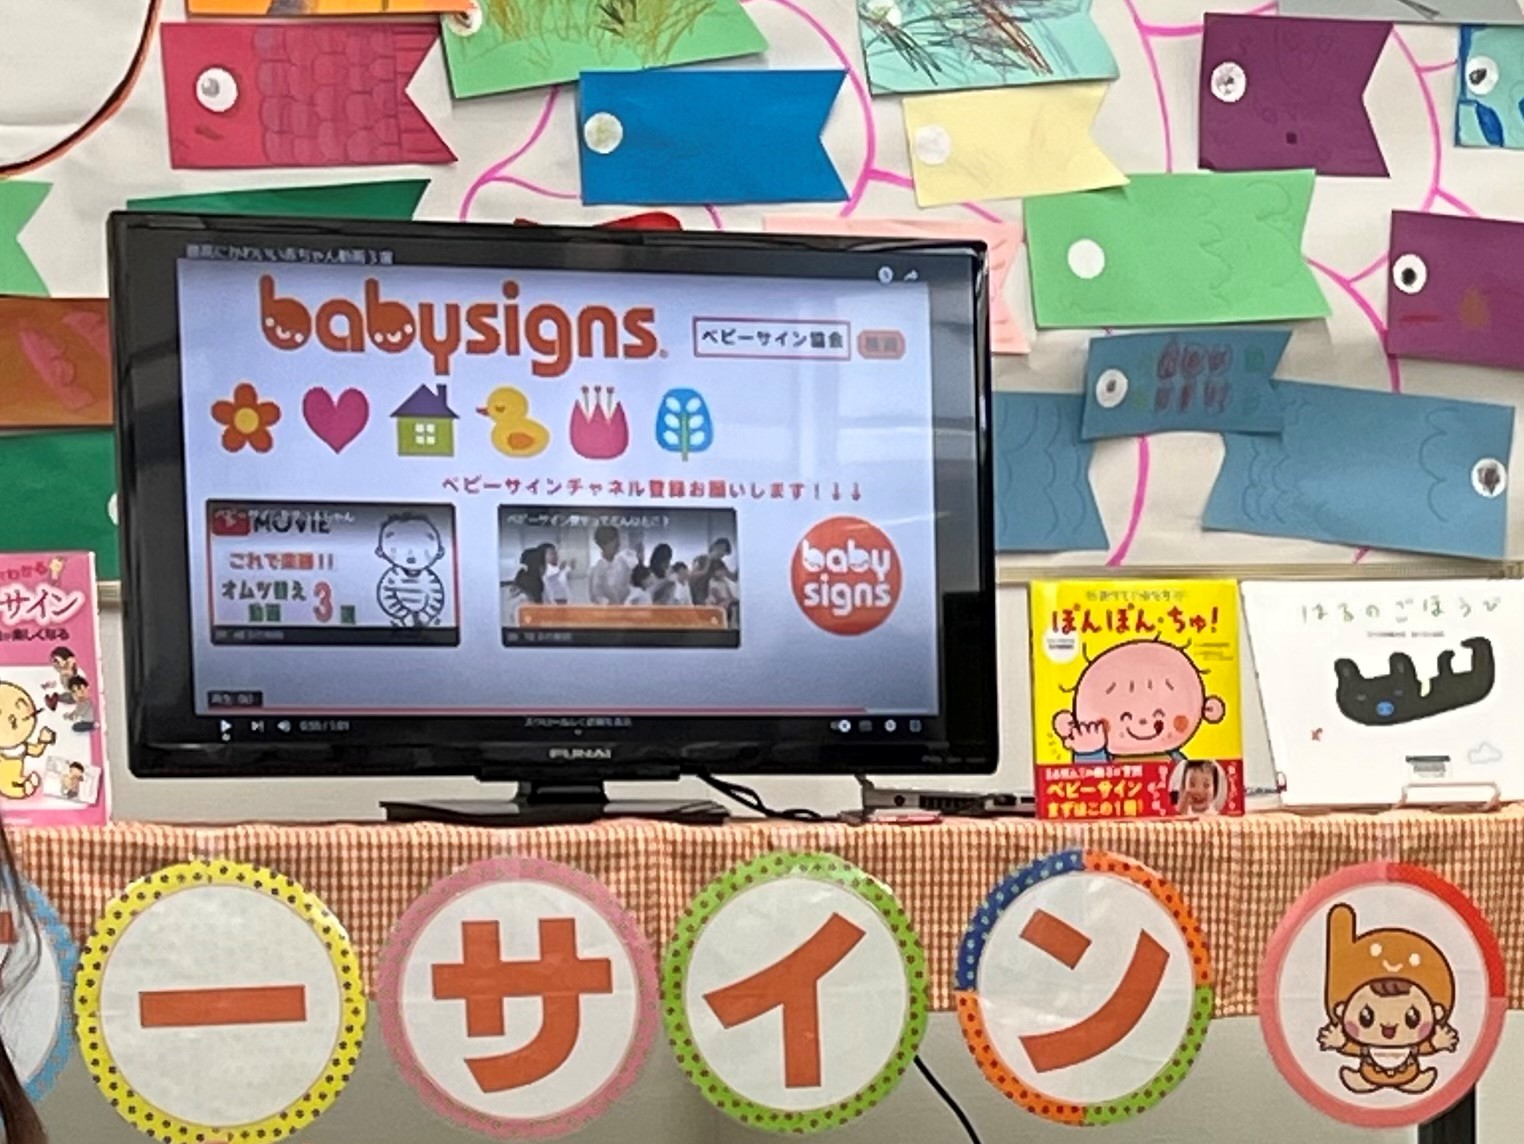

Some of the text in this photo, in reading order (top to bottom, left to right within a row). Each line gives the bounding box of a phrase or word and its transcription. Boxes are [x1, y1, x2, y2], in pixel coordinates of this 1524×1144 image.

[259, 273, 658, 378] babysigns
[801, 538, 892, 582] baby
[803, 572, 892, 617] signs
